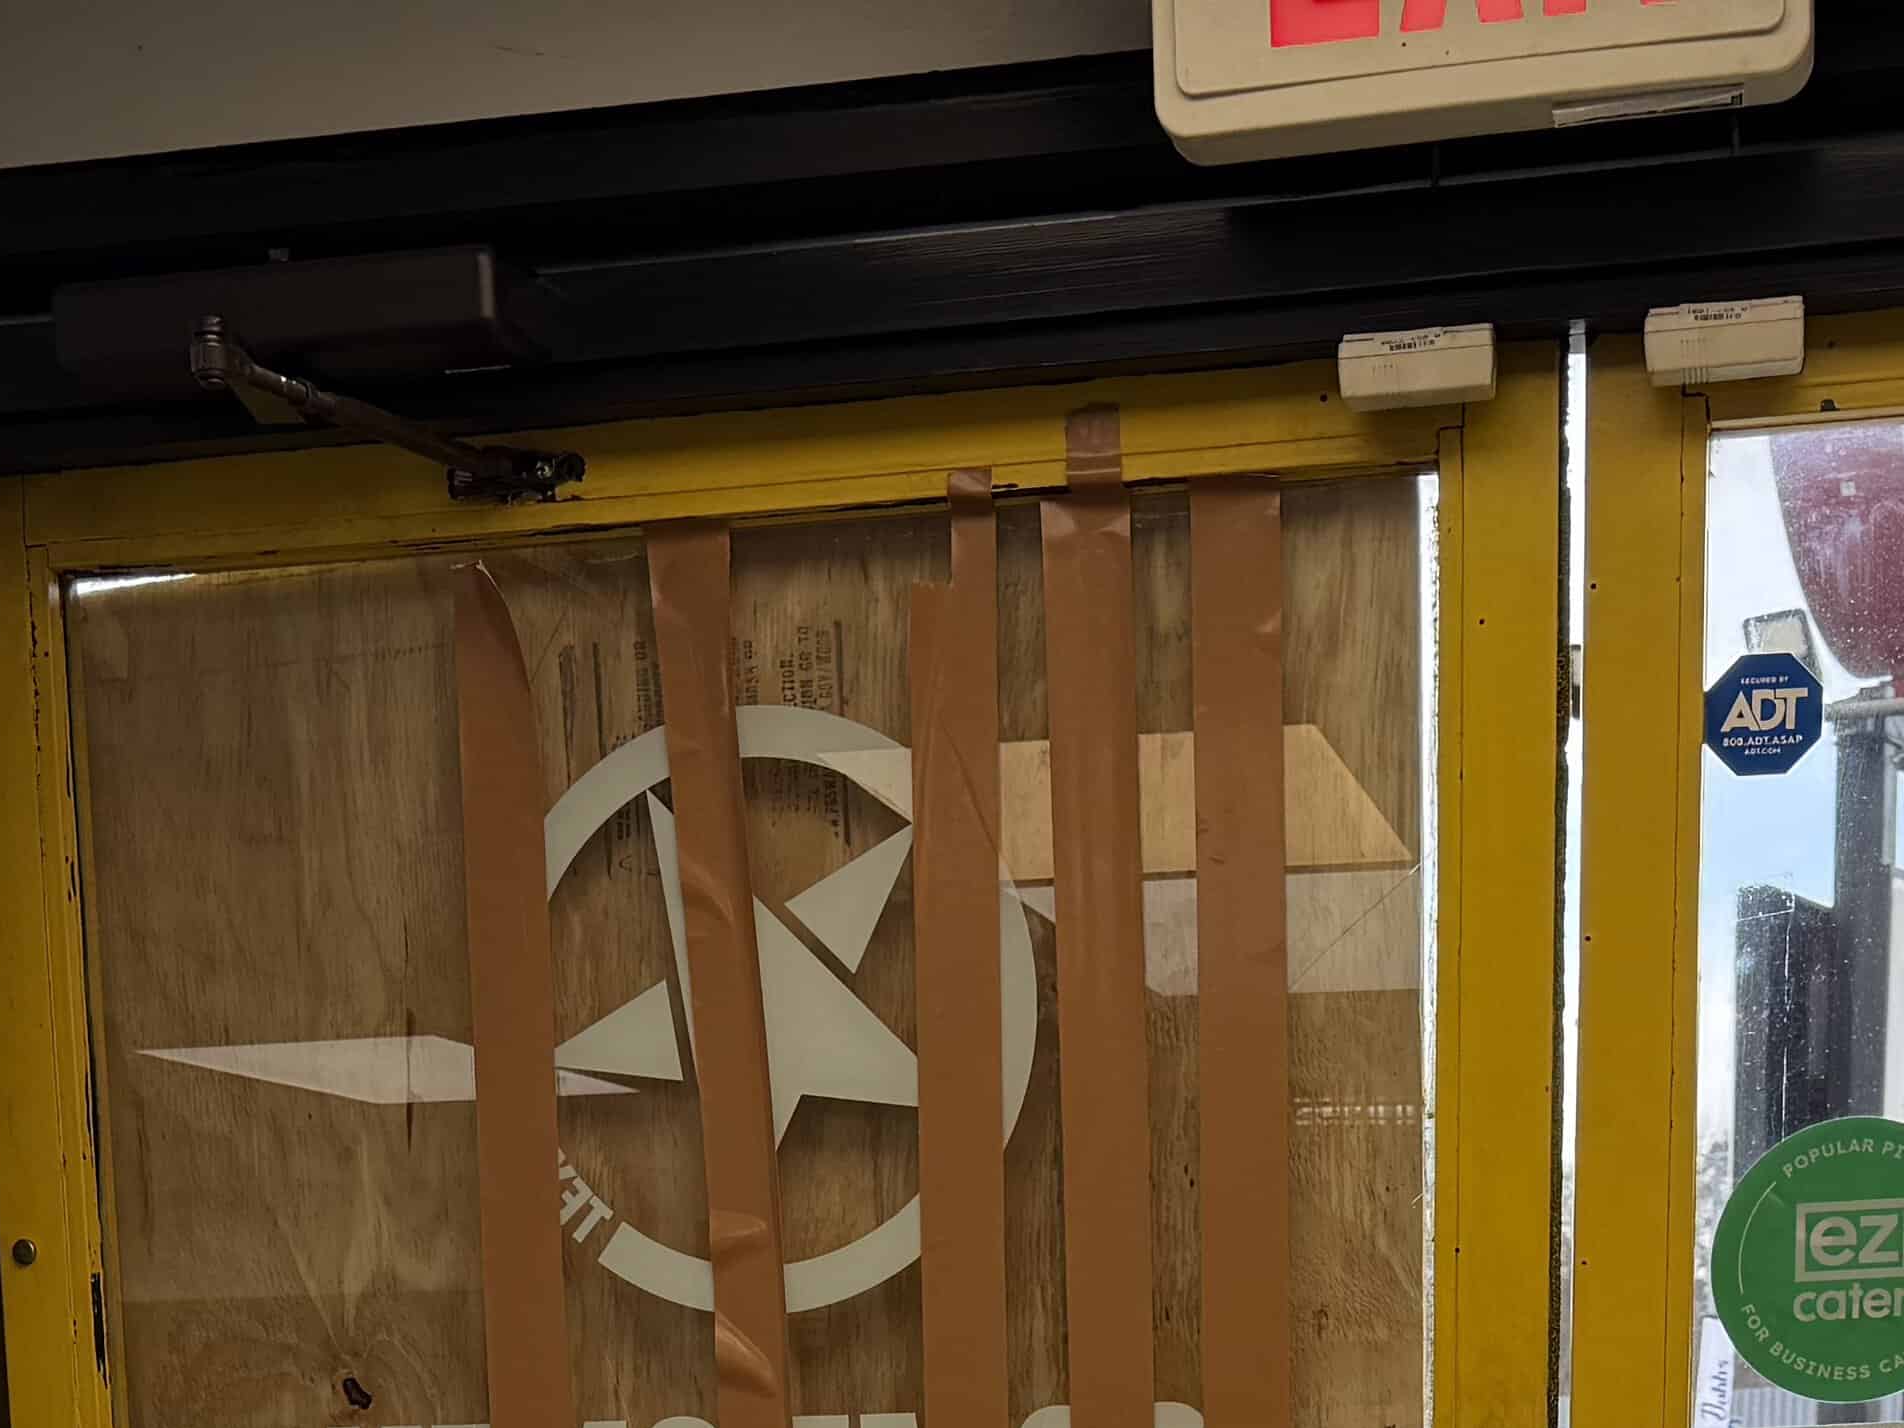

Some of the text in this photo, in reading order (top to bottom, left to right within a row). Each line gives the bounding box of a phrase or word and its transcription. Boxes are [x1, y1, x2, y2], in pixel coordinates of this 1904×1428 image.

[1720, 687, 1809, 732] ADT
[1782, 1138, 1875, 1179] POPULAR
[1809, 1214, 1899, 1266] ez
[1742, 1303, 1770, 1343] FOR
[1770, 1341, 1872, 1381] BUSINESS
